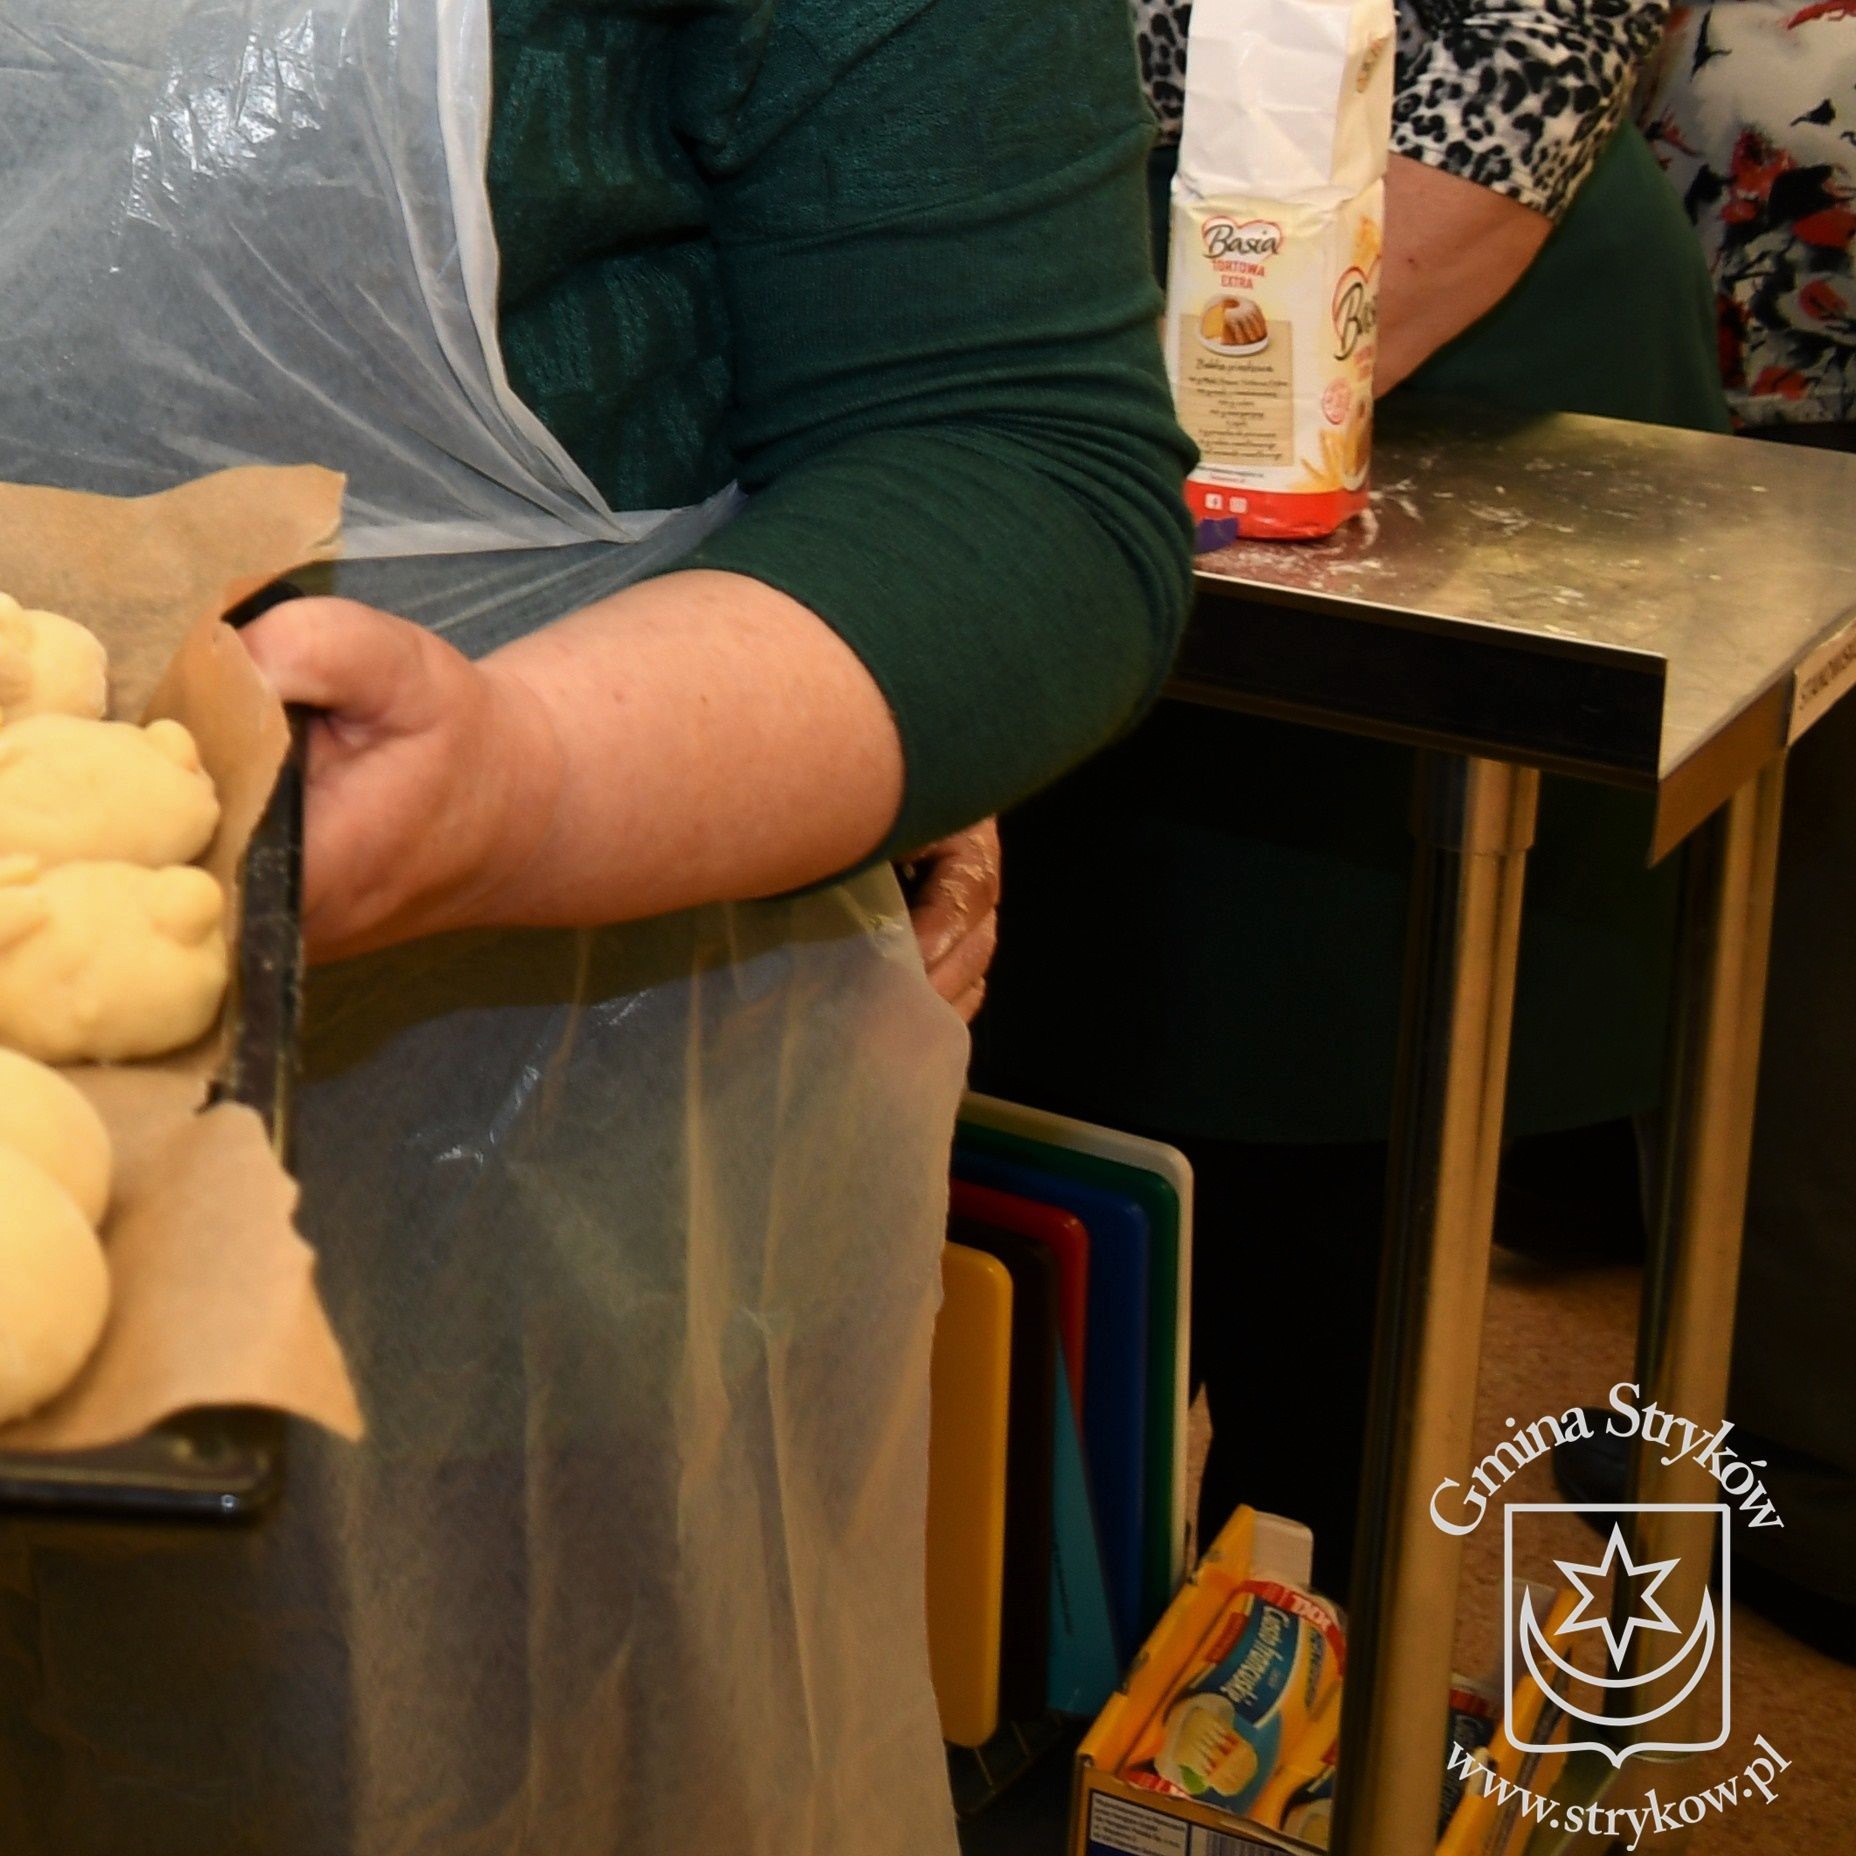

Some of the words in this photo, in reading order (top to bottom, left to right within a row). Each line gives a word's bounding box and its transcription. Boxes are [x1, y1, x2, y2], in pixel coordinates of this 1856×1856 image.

[1202, 223, 1279, 259] Basia
[1211, 259, 1265, 277] TORTOWA
[1221, 275, 1253, 289] EXTRA
